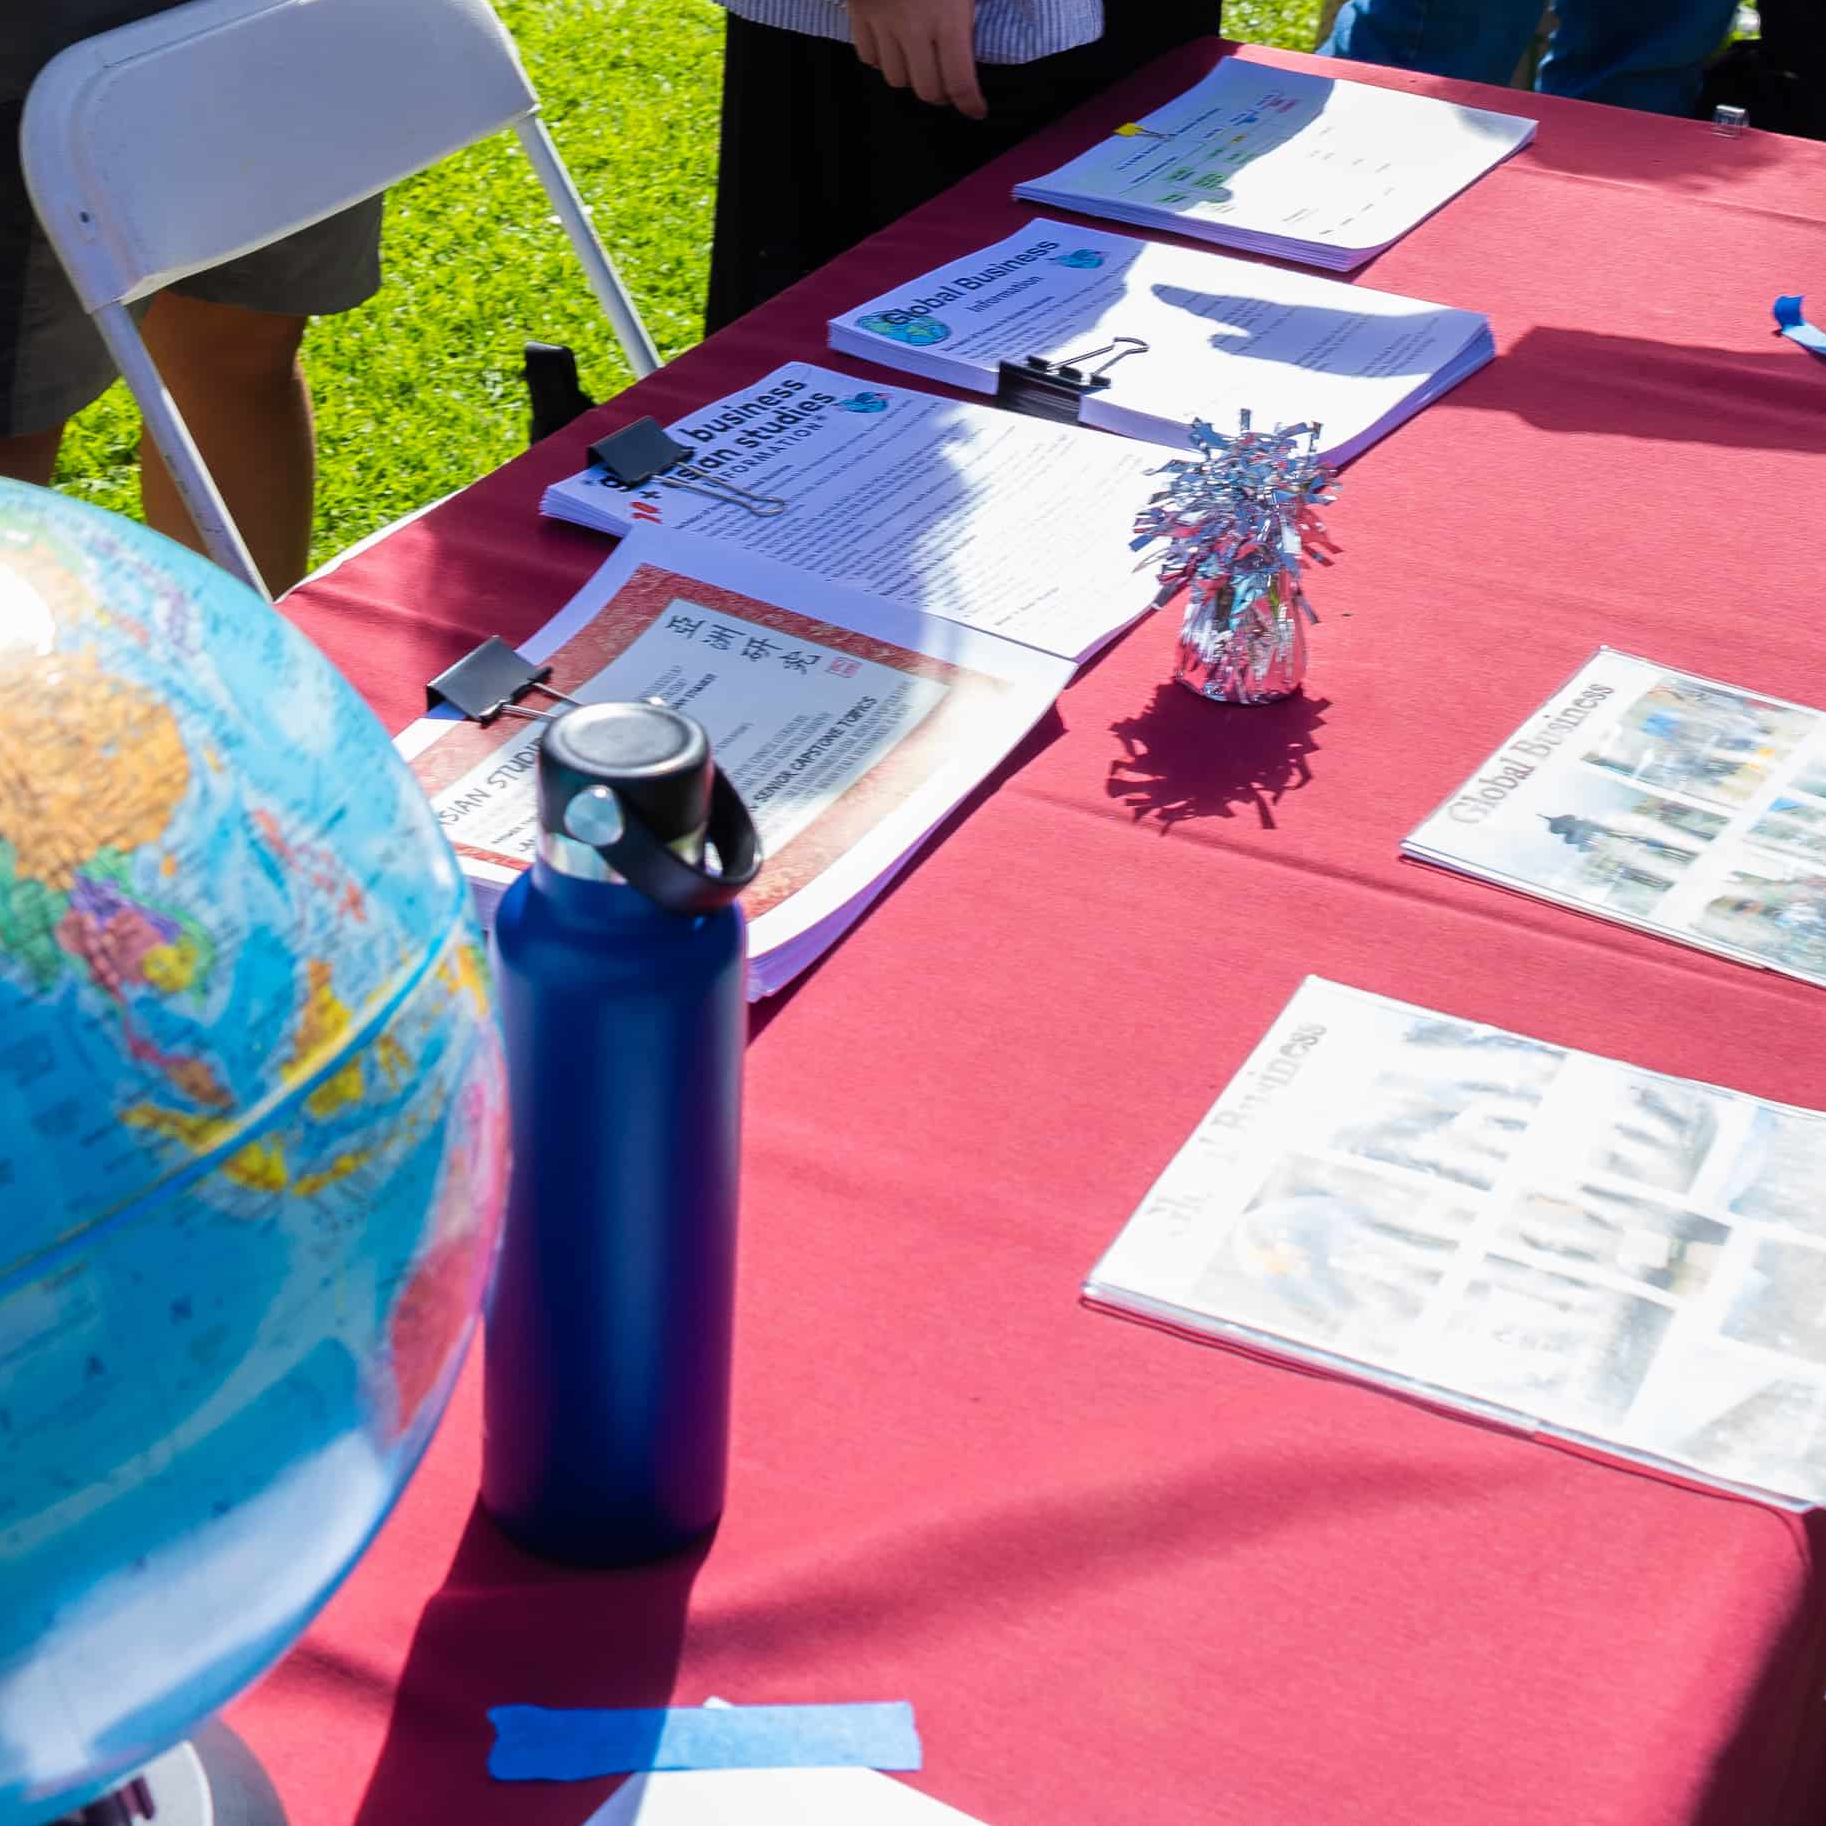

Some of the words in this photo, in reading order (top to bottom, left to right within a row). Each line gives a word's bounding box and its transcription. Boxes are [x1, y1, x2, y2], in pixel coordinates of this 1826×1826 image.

[882, 286, 964, 327] Global
[956, 238, 1061, 292] Business
[964, 275, 1043, 313] Information
[678, 374, 808, 444] business
[734, 389, 837, 454] studies
[752, 767, 798, 804] SENIOR
[789, 726, 844, 778] CAPSTONE
[836, 694, 878, 730] TOPICS
[1447, 756, 1536, 825] Global
[1509, 682, 1615, 762] Business
